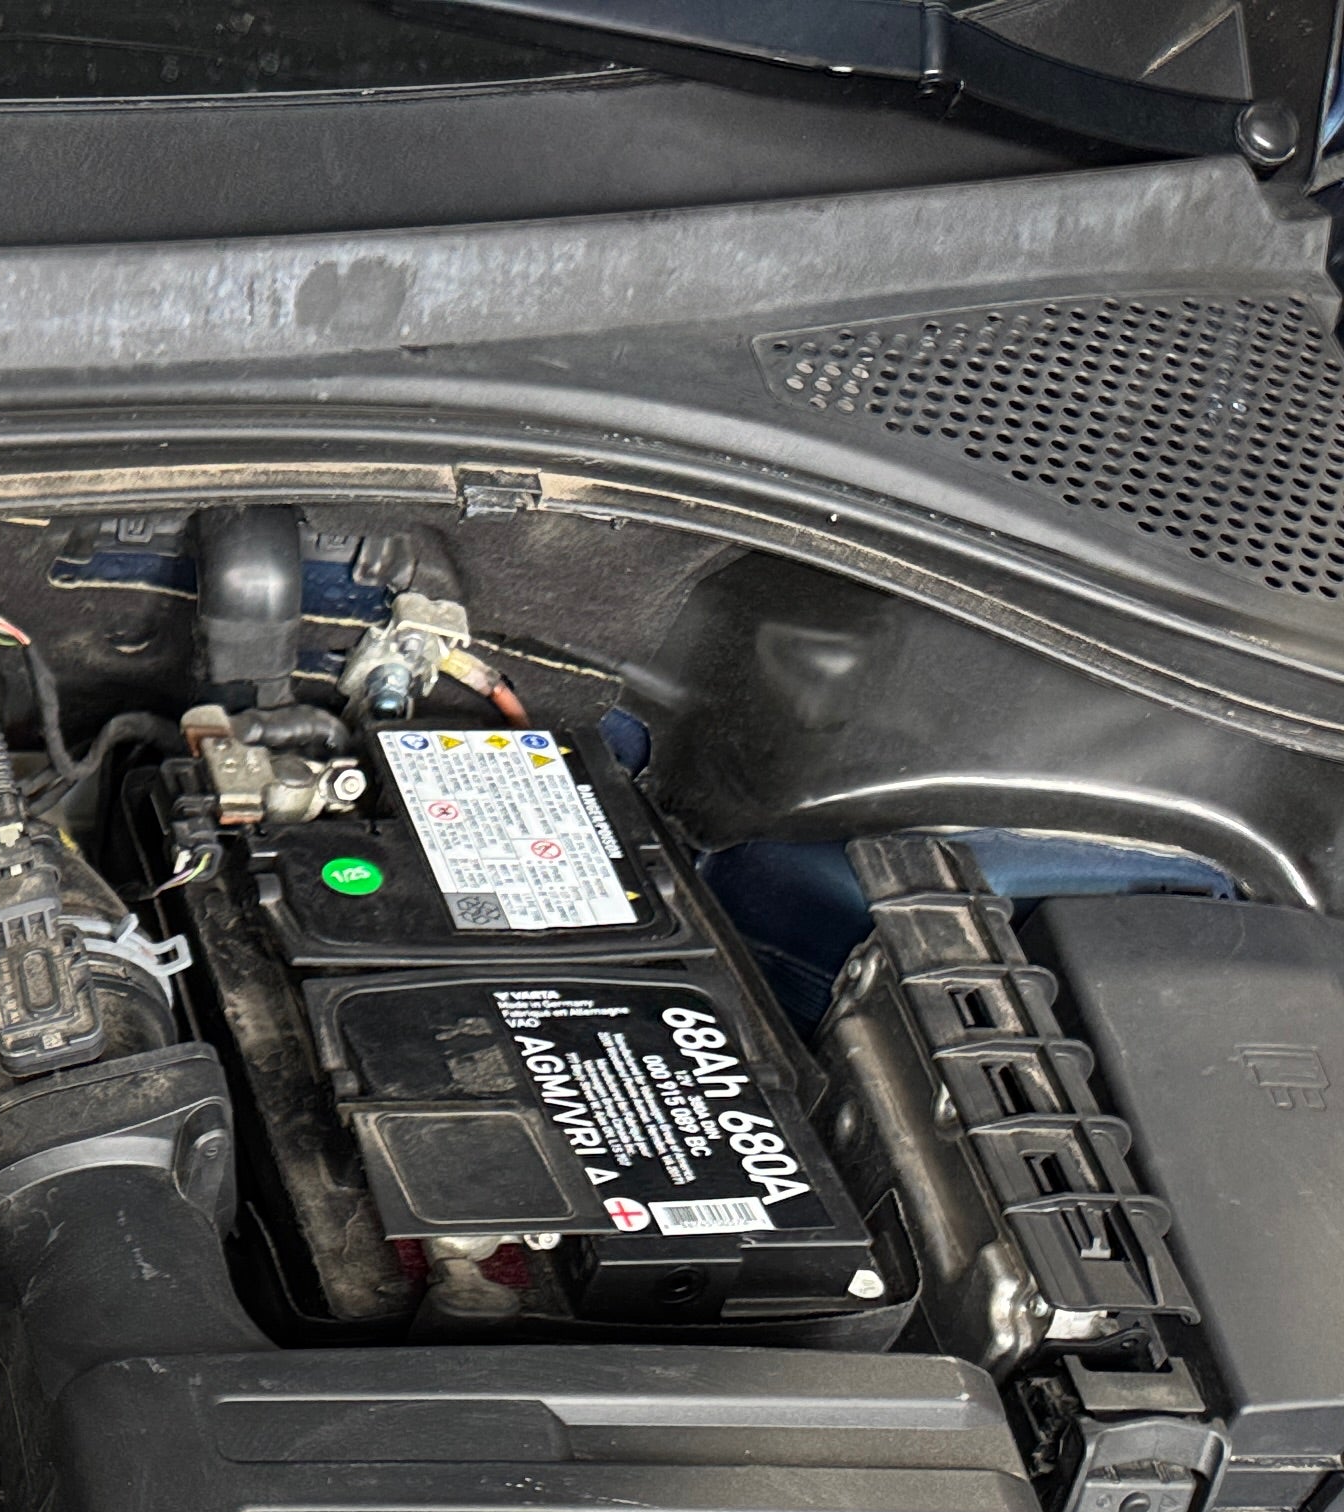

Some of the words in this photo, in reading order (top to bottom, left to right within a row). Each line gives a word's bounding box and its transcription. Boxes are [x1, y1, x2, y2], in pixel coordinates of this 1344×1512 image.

[497, 1001, 529, 1009] Made
[530, 1000, 542, 1009] in
[542, 1000, 595, 1009] Germany
[642, 1055, 672, 1080] 000
[656, 1080, 686, 1106] 915
[662, 1007, 750, 1098] 68Ah
[718, 1110, 811, 1205] 680A
[674, 1070, 695, 1087] 12V
[700, 1119, 722, 1140] DIN
[670, 1107, 701, 1133] 089
[684, 1136, 712, 1158] BC
